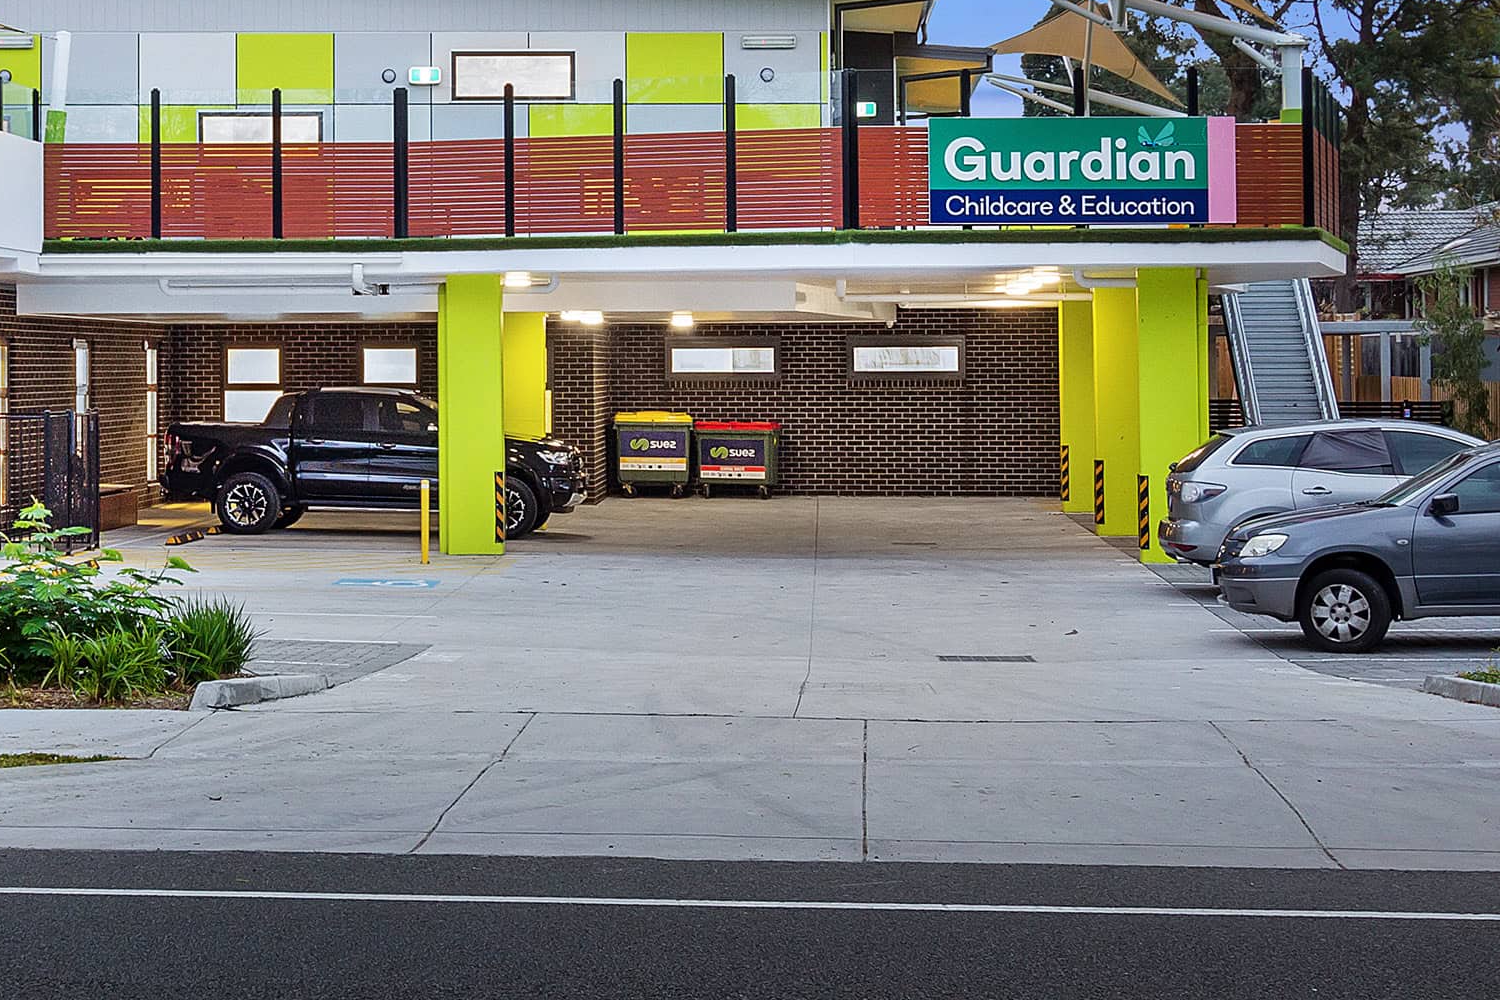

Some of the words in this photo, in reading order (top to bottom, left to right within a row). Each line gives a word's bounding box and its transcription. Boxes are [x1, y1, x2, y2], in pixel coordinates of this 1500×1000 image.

[944, 137, 1195, 181] Guardian
[945, 195, 1054, 216] Childcare
[1058, 195, 1076, 216] &
[1081, 195, 1195, 216] Education
